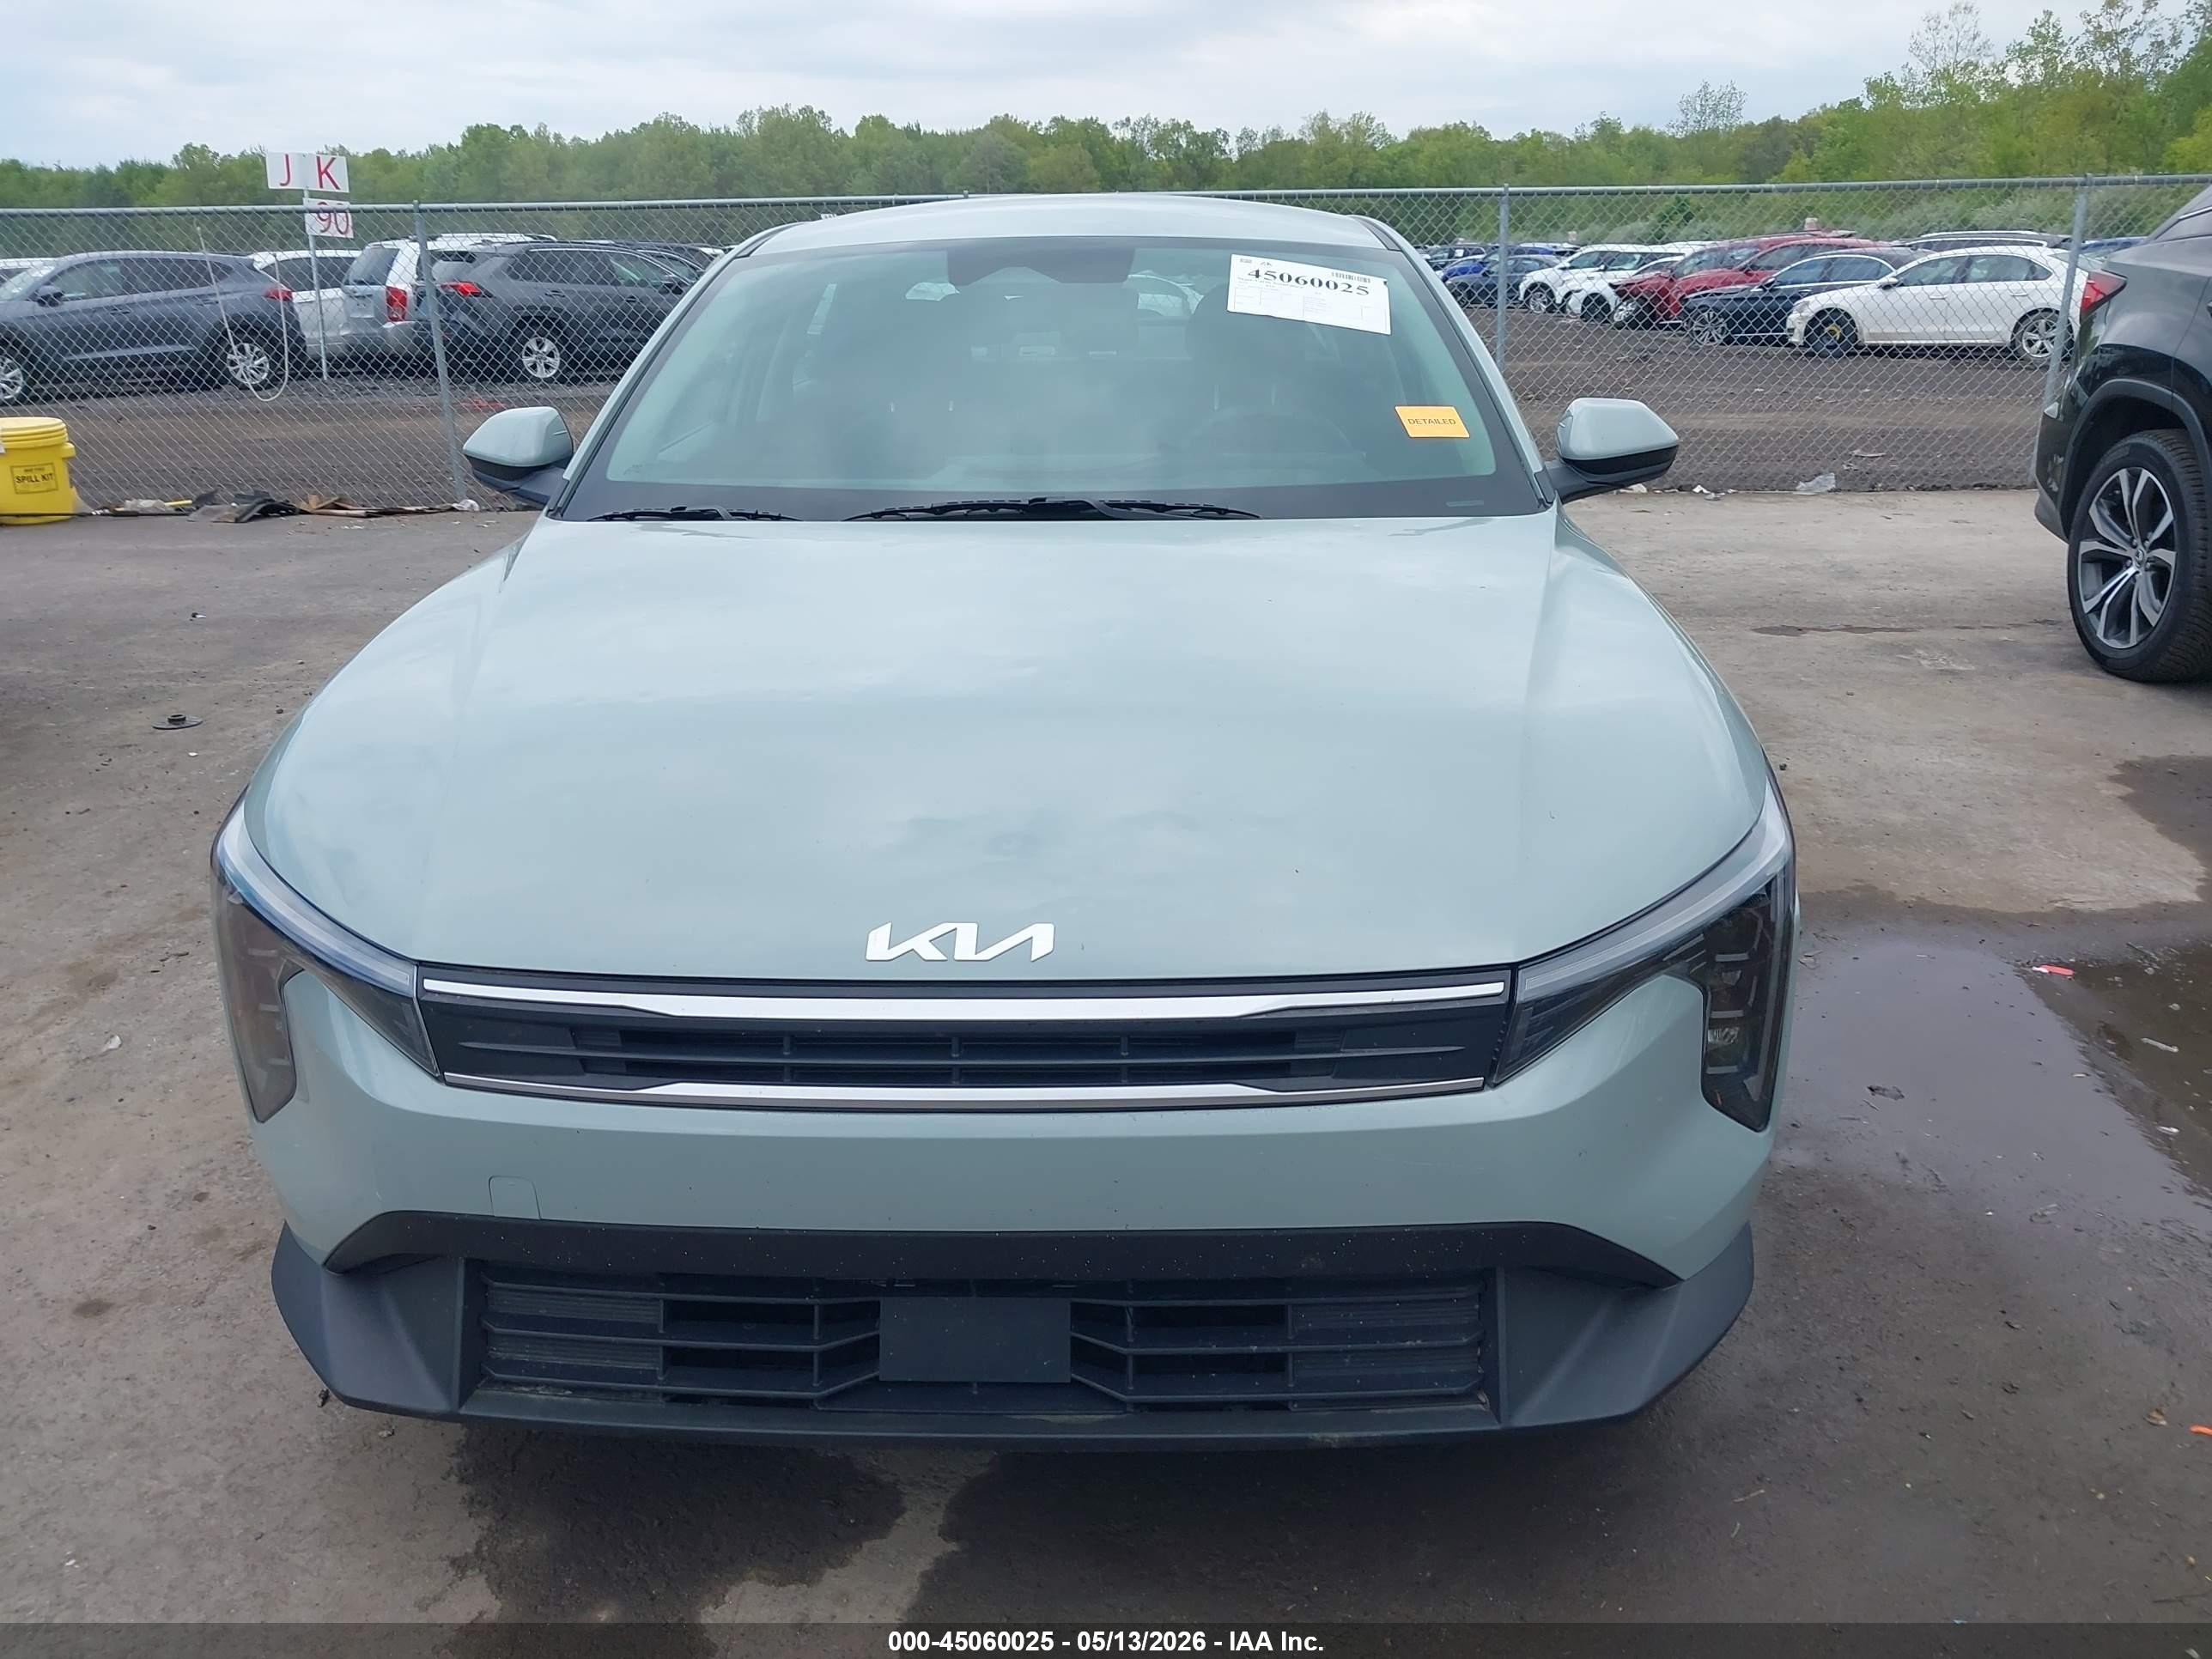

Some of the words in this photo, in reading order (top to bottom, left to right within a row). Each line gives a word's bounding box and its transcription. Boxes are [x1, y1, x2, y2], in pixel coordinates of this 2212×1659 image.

[279, 153, 291, 186] J
[316, 155, 341, 191] K
[317, 202, 349, 235] 90
[1248, 268, 1370, 296] 45060025
[15, 474, 40, 483] SPILL
[40, 472, 53, 482] KIT
